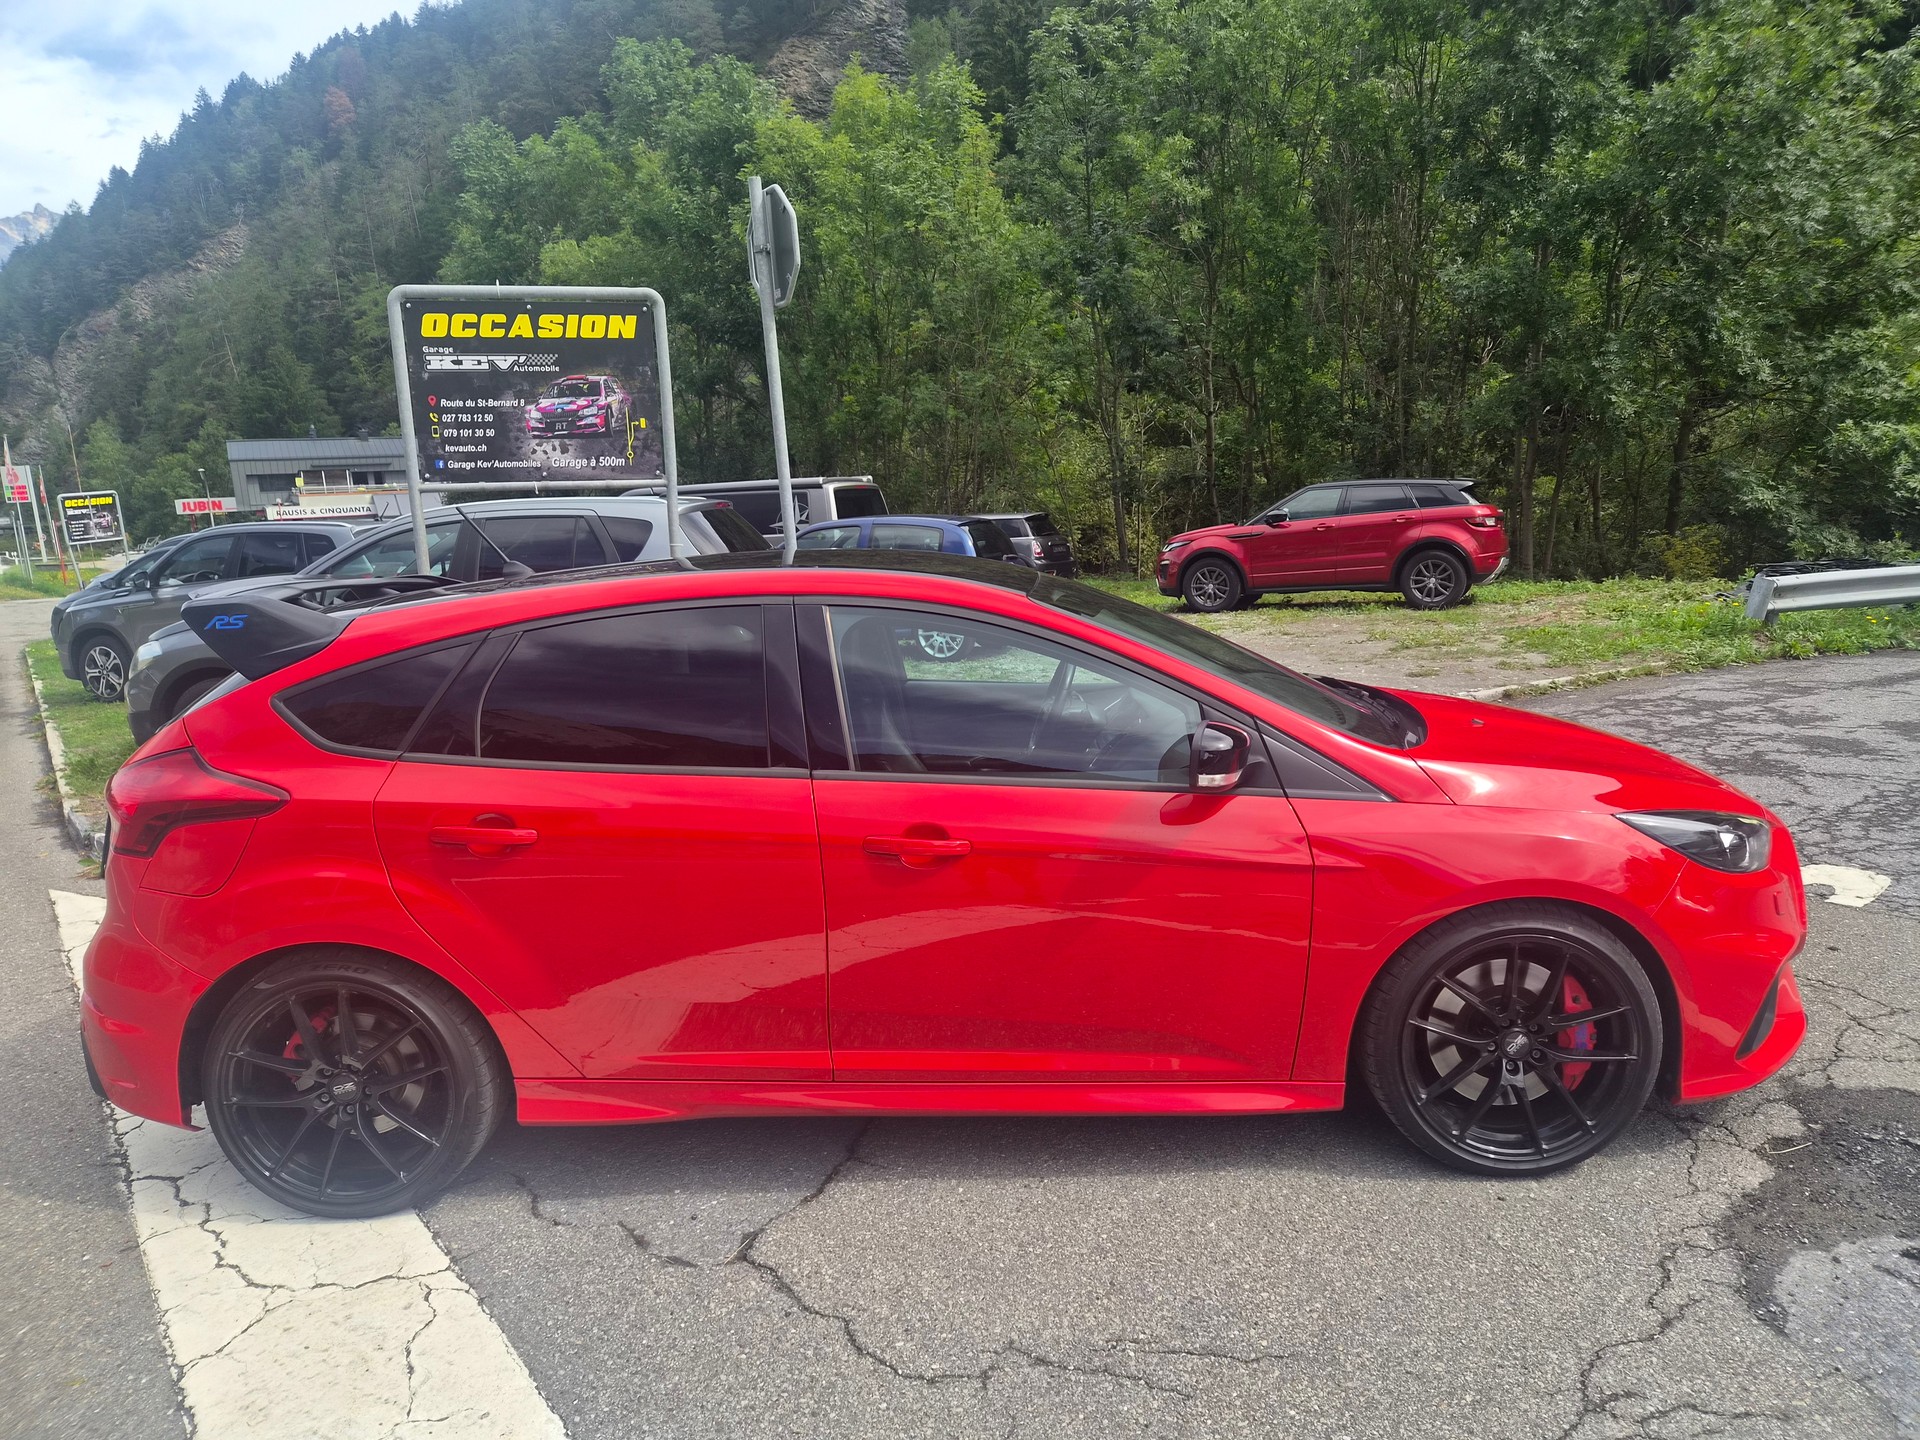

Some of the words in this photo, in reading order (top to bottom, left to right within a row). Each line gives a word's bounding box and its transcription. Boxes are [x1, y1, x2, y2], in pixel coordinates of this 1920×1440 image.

[421, 313, 637, 339] OCCASION
[422, 346, 454, 354] Garage
[440, 399, 463, 407] Route
[465, 399, 475, 407] du
[477, 399, 518, 407] St-Bernard
[520, 399, 525, 407] 8
[442, 414, 455, 422] 027
[458, 414, 471, 422] 783
[474, 414, 482, 422] 12
[484, 414, 493, 422] 50
[443, 429, 457, 437] 079
[459, 429, 472, 437] 101
[474, 429, 484, 437] 30
[486, 429, 495, 437] 50
[445, 444, 487, 452] kevauto.ch
[448, 460, 475, 470] Garage
[477, 460, 541, 468] Kev'Automobiles
[552, 458, 588, 469] Garage
[590, 456, 596, 467] à
[599, 456, 625, 466] 500m
[65, 497, 113, 507] OCCASION
[276, 508, 307, 517] RAUSIS
[319, 506, 372, 514] CINQUANTA
[204, 614, 249, 630] RS
